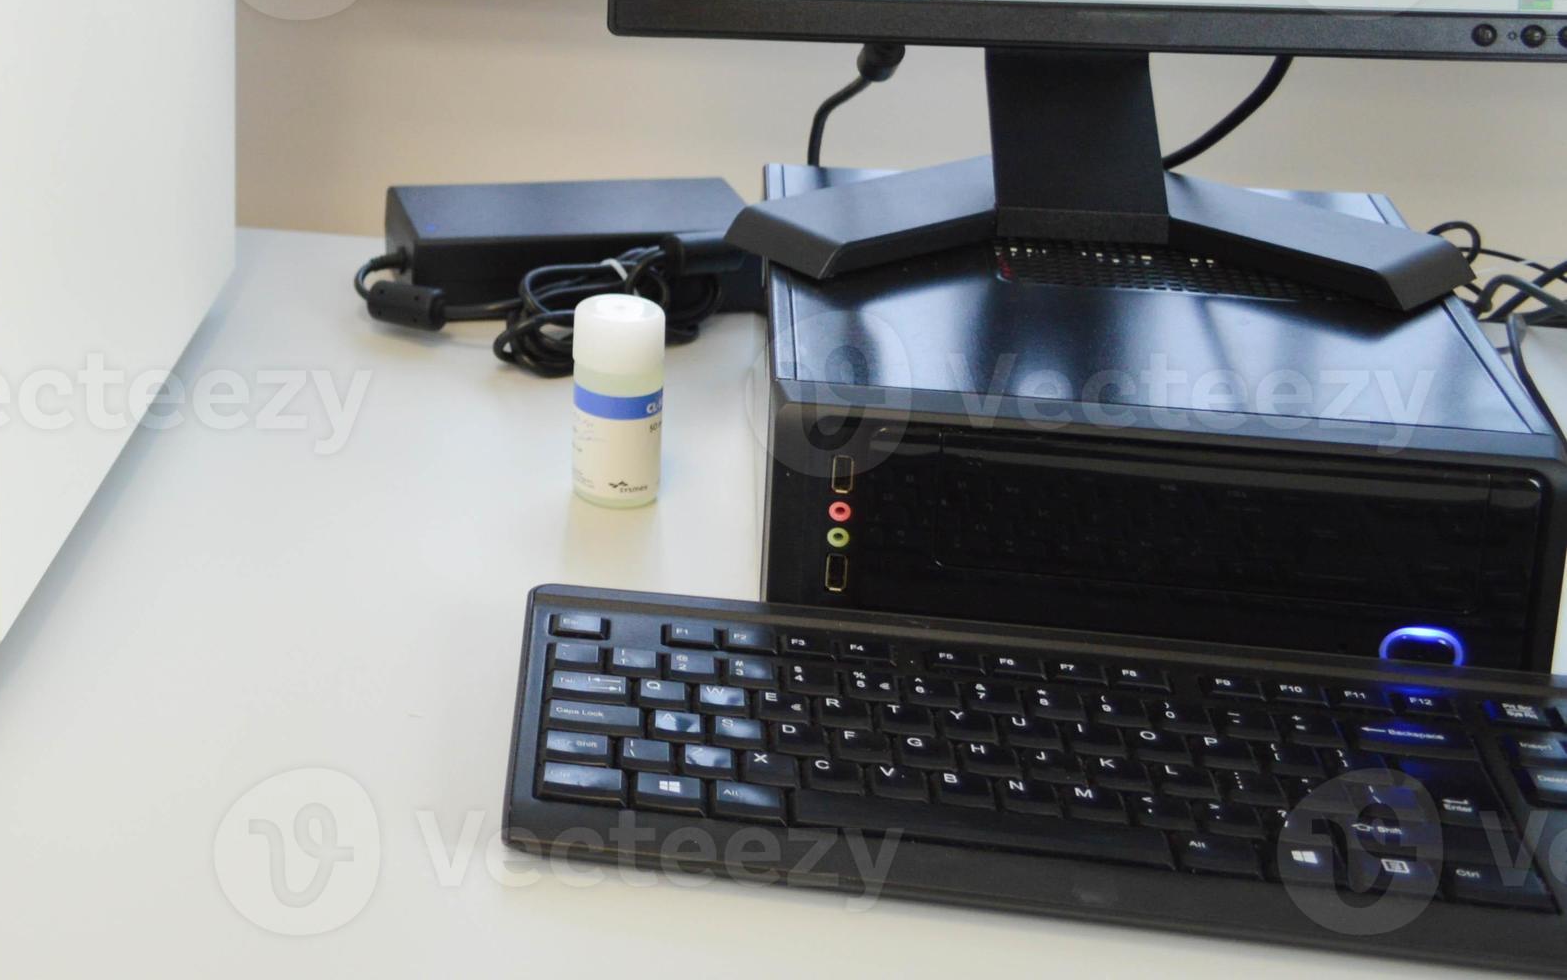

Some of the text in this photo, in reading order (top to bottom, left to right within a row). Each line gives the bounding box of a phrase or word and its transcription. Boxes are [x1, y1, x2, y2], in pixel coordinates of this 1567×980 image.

[676, 627, 689, 636] F1
[734, 632, 747, 641] F2
[791, 638, 806, 647] F3
[850, 644, 864, 652] F4
[939, 652, 954, 660] F5
[999, 657, 1014, 666] F6
[1060, 663, 1075, 671] F7
[1122, 669, 1137, 677] F8
[646, 681, 662, 691] Q
[1215, 678, 1231, 686] F9
[706, 685, 725, 694] W
[1280, 684, 1303, 694] F10
[765, 692, 778, 702] E
[1344, 690, 1366, 699] F11
[825, 698, 841, 708] R
[1409, 697, 1433, 707] F12
[582, 707, 605, 718] Lock
[887, 704, 901, 714] T
[662, 712, 676, 721] A
[950, 710, 964, 720] Y
[721, 718, 734, 728] S
[1012, 716, 1026, 727] U
[782, 724, 796, 734] D
[1388, 728, 1444, 740] Backspace
[844, 730, 857, 740] F
[1140, 730, 1156, 741] O
[907, 737, 923, 748] G
[1204, 736, 1218, 746] P
[970, 743, 985, 754] H
[753, 753, 769, 764] X
[1036, 751, 1046, 761] J
[815, 760, 830, 770] C
[1099, 758, 1115, 768] K
[879, 765, 894, 777] V
[1165, 765, 1178, 775] L
[943, 773, 958, 784] B
[1009, 780, 1025, 791] N
[1074, 787, 1094, 799] M
[1456, 868, 1481, 878] Ctrl
